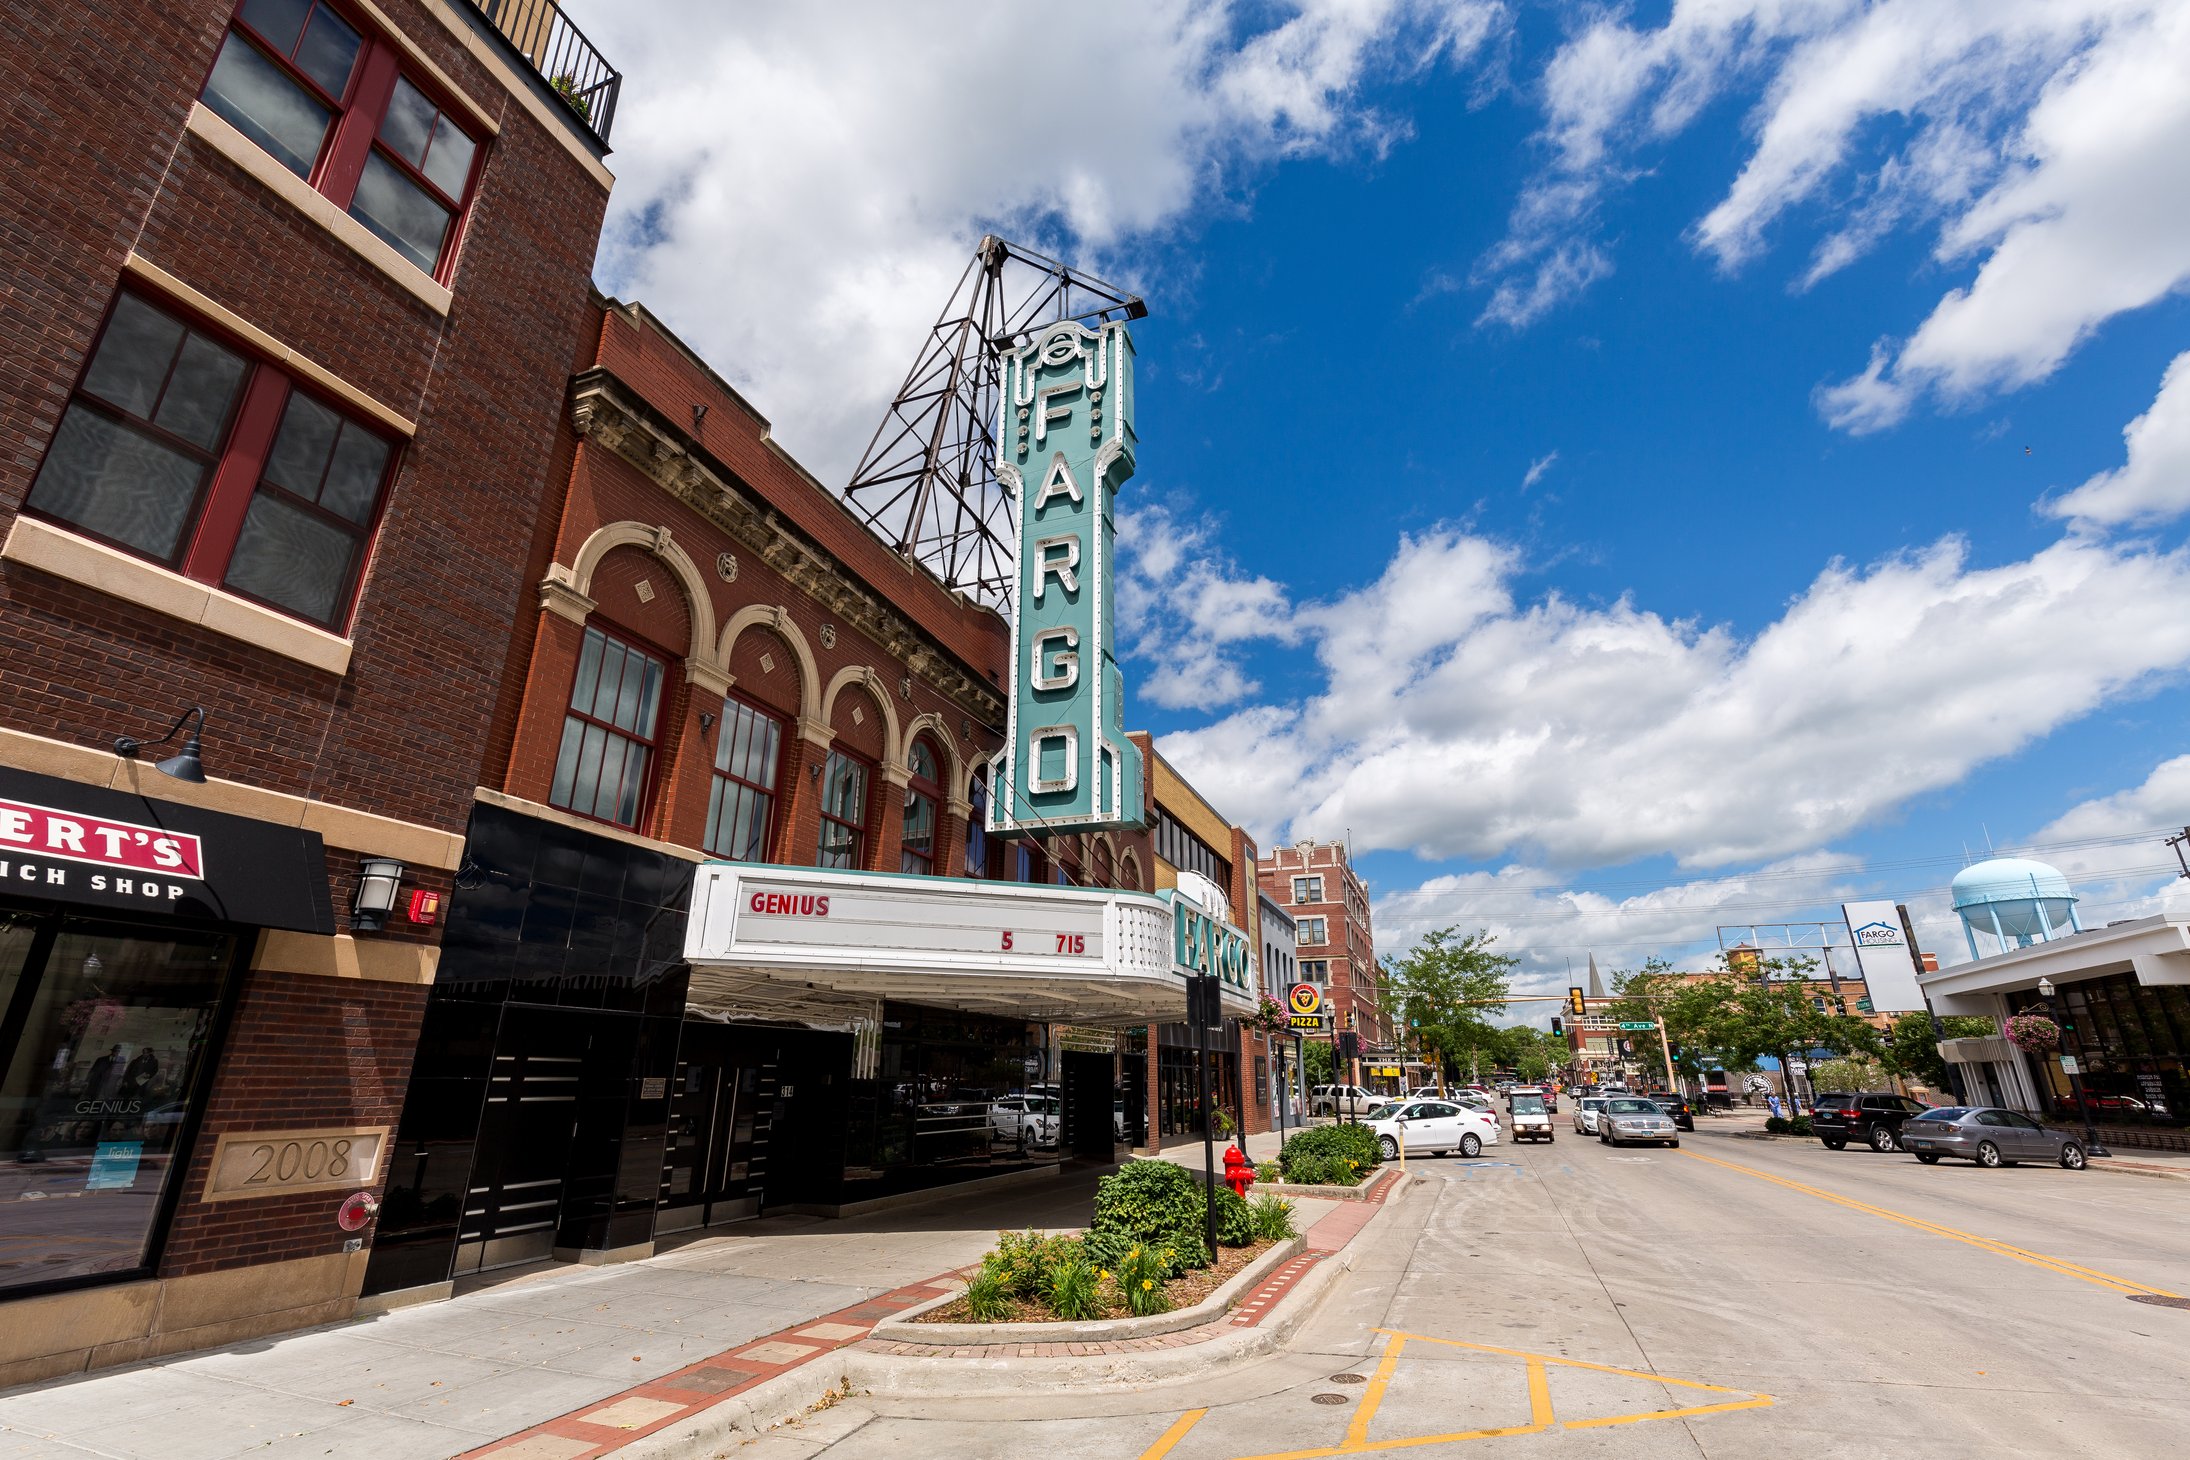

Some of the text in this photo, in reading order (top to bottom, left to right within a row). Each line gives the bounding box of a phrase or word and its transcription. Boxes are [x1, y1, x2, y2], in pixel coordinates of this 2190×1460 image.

[1028, 381, 1083, 795] FARGO
[91, 875, 184, 899] SHOP
[750, 892, 829, 916] GENIUS
[1001, 931, 1013, 951] 5
[1861, 930, 1894, 938] FARGO
[1178, 903, 1250, 989] FARGO
[1291, 1017, 1319, 1026] PIZZA
[75, 1100, 142, 1114] GENIUS
[109, 1147, 133, 1159] light
[243, 1139, 352, 1185] 2008
